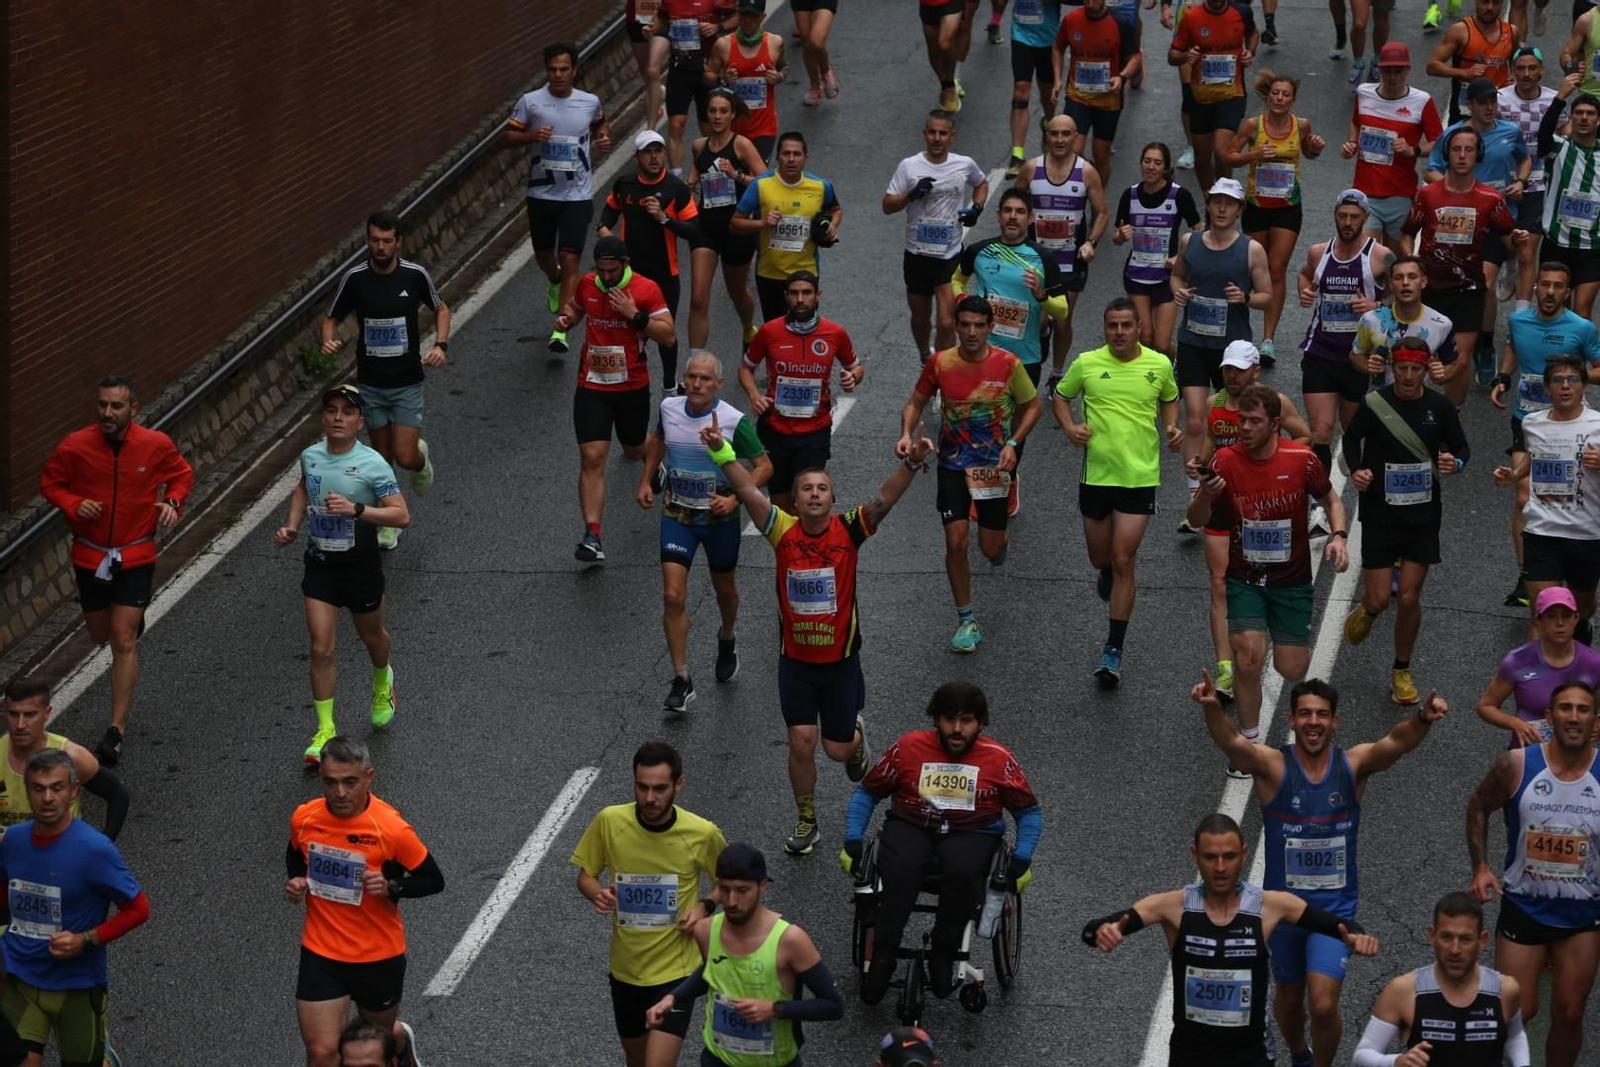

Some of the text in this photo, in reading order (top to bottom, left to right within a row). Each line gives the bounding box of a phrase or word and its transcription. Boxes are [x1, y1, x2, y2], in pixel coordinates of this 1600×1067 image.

[1364, 135, 1388, 149] 2770
[1565, 199, 1591, 214] 2610
[1438, 215, 1466, 228] 4427
[922, 225, 947, 239] 1906
[1326, 276, 1359, 286] HIGHAM
[991, 304, 1019, 321] 3952
[369, 328, 397, 341] 2702
[782, 386, 811, 400] 2330
[972, 469, 1000, 482] 5504
[1536, 462, 1562, 477] 2416
[1392, 473, 1423, 487] 3243
[314, 517, 342, 533] 1631
[1249, 530, 1280, 545] 1502
[793, 580, 824, 595] 1866
[924, 774, 968, 790] 14390
[1563, 803, 1600, 817] ATLETISMO
[1534, 836, 1575, 855] 4145
[1295, 851, 1333, 868] 1802
[314, 857, 350, 880] 2864
[624, 887, 663, 906] 3062
[16, 894, 48, 916] 2845
[1194, 981, 1236, 1002] 2507
